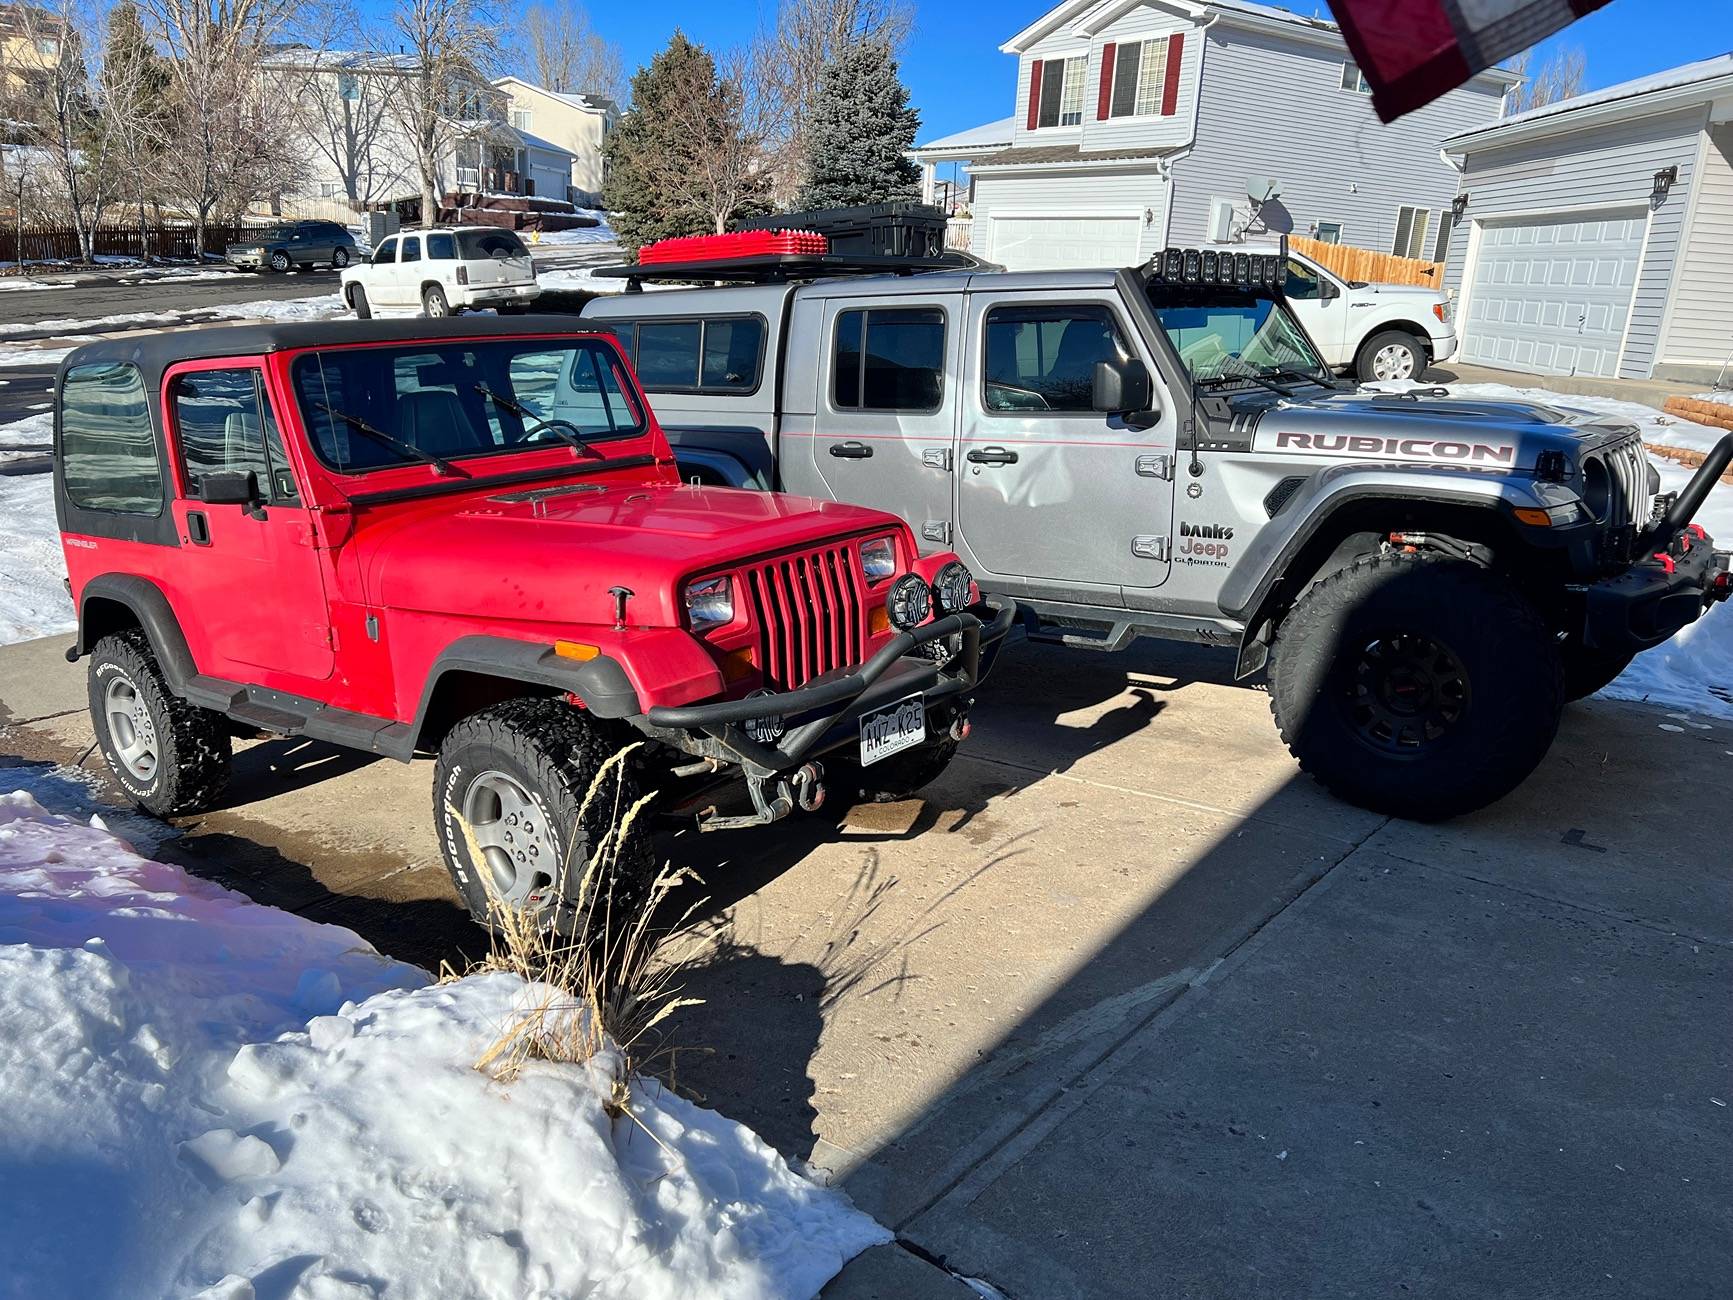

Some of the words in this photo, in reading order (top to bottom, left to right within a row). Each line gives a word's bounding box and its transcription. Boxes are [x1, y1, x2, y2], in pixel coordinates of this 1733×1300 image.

[1276, 432, 1514, 463] RUBICON
[1180, 521, 1234, 540] banks
[1180, 538, 1229, 560] Jeep
